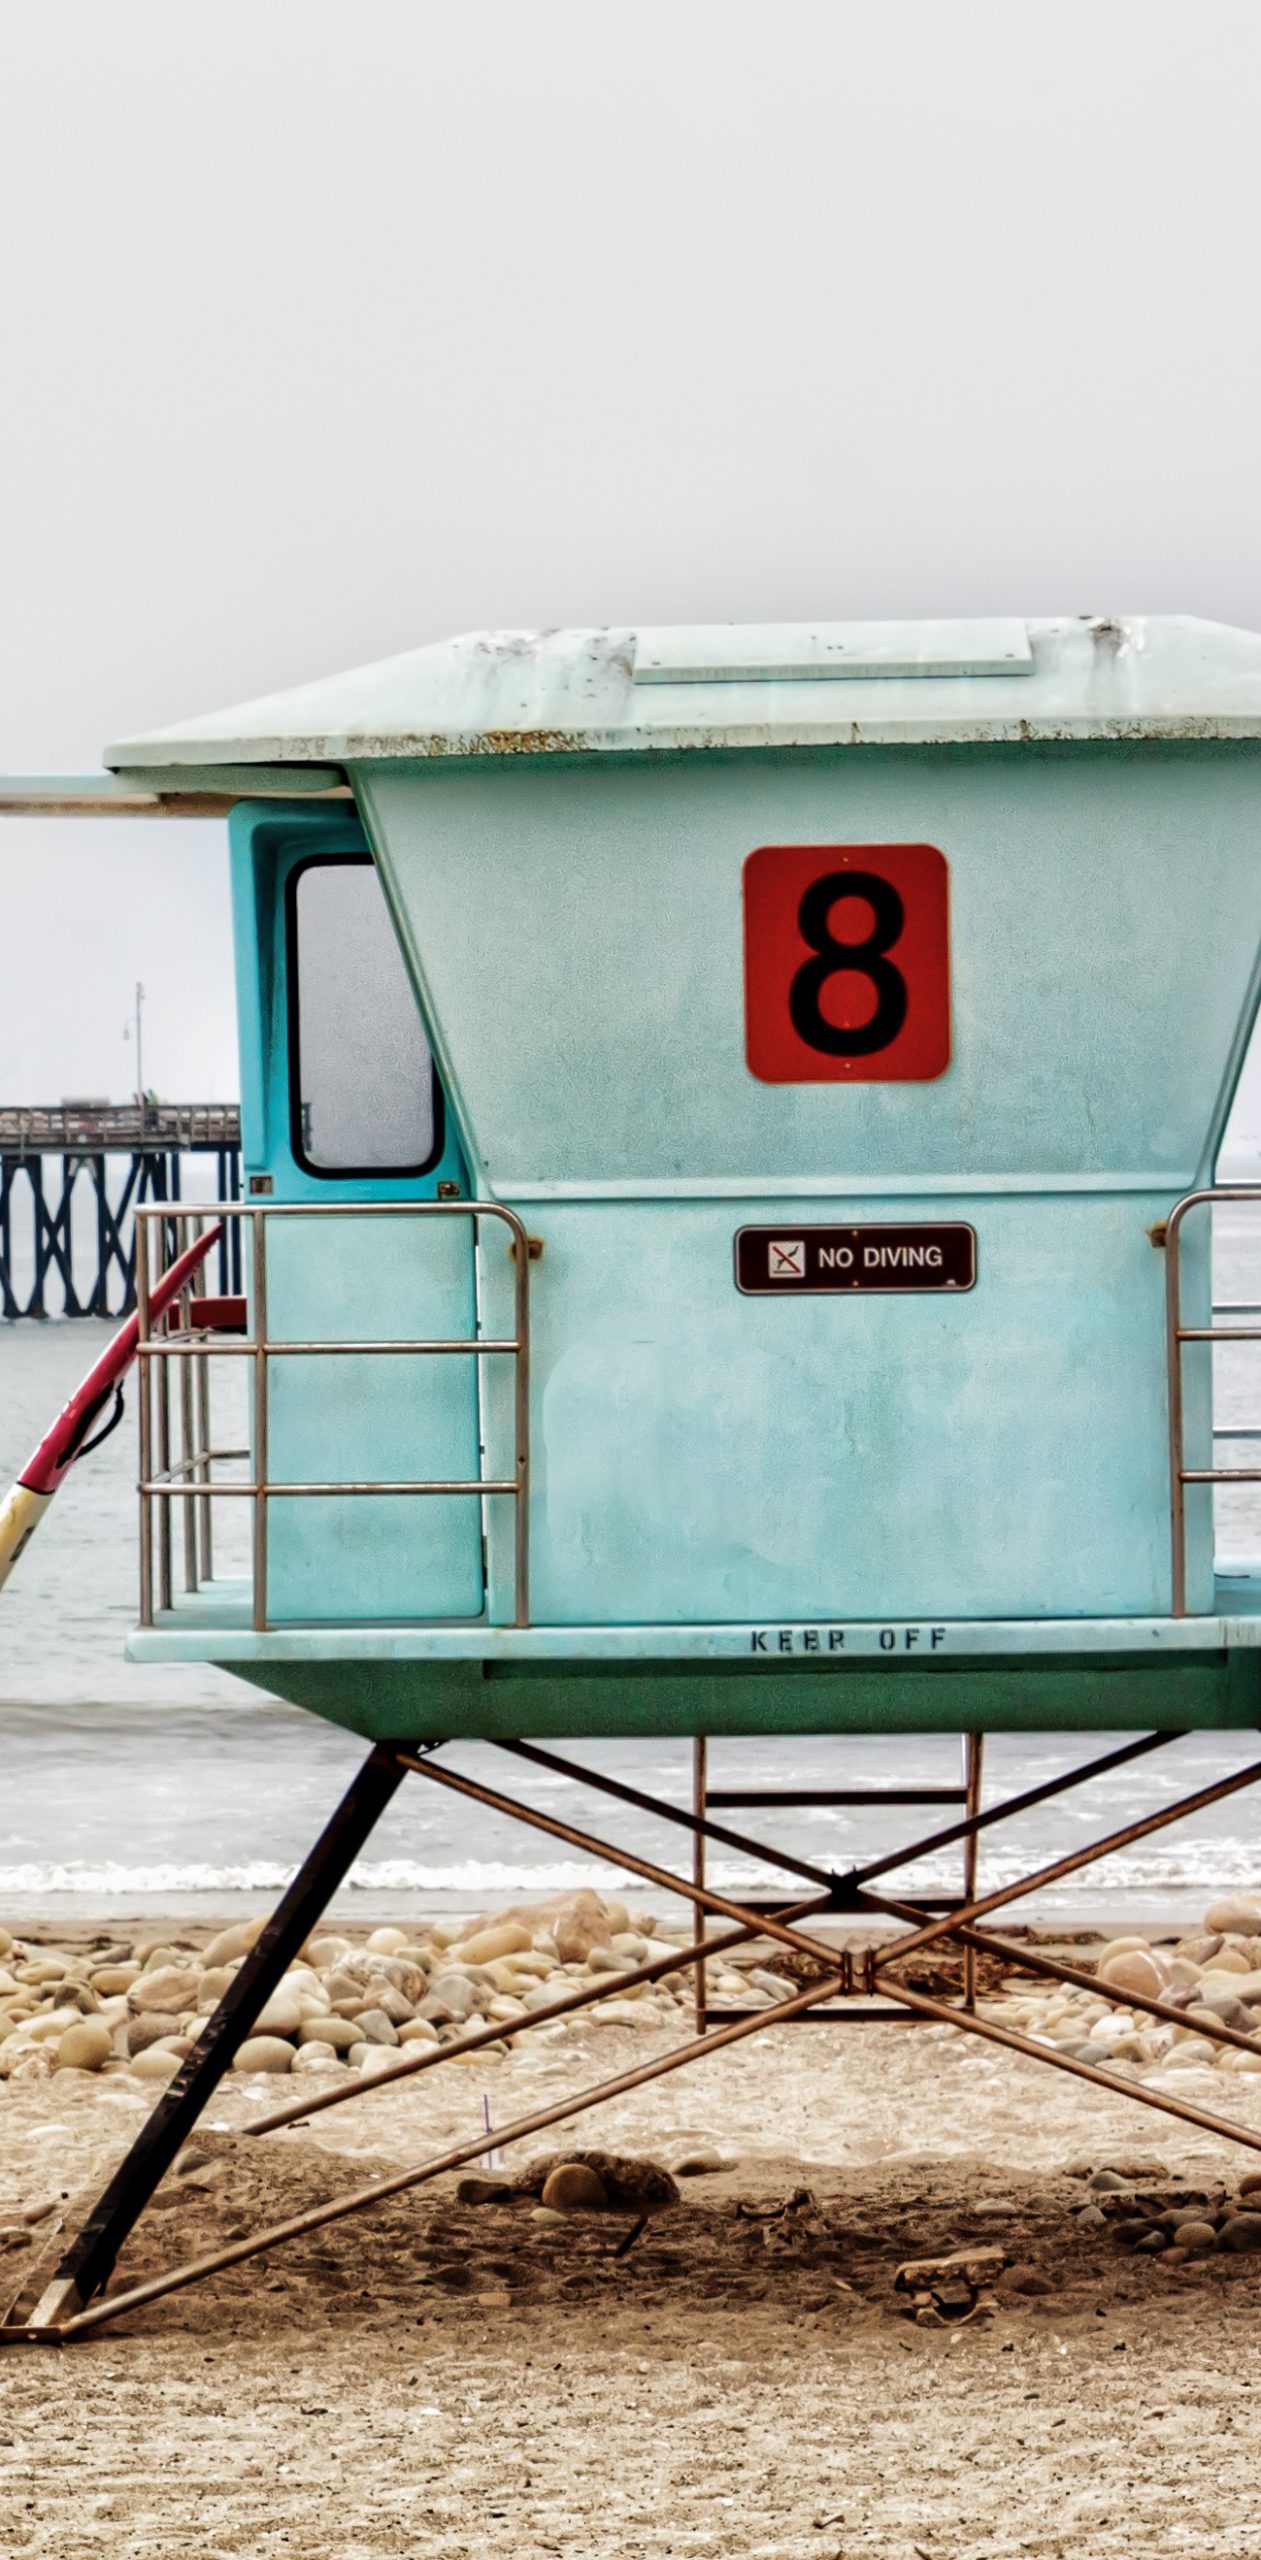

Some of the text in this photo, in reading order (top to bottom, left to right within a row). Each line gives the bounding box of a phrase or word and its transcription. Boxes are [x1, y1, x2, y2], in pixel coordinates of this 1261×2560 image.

[789, 871, 908, 1057] 8
[819, 1246, 943, 1268] NO DIVING
[879, 1628, 946, 1650] OFF
